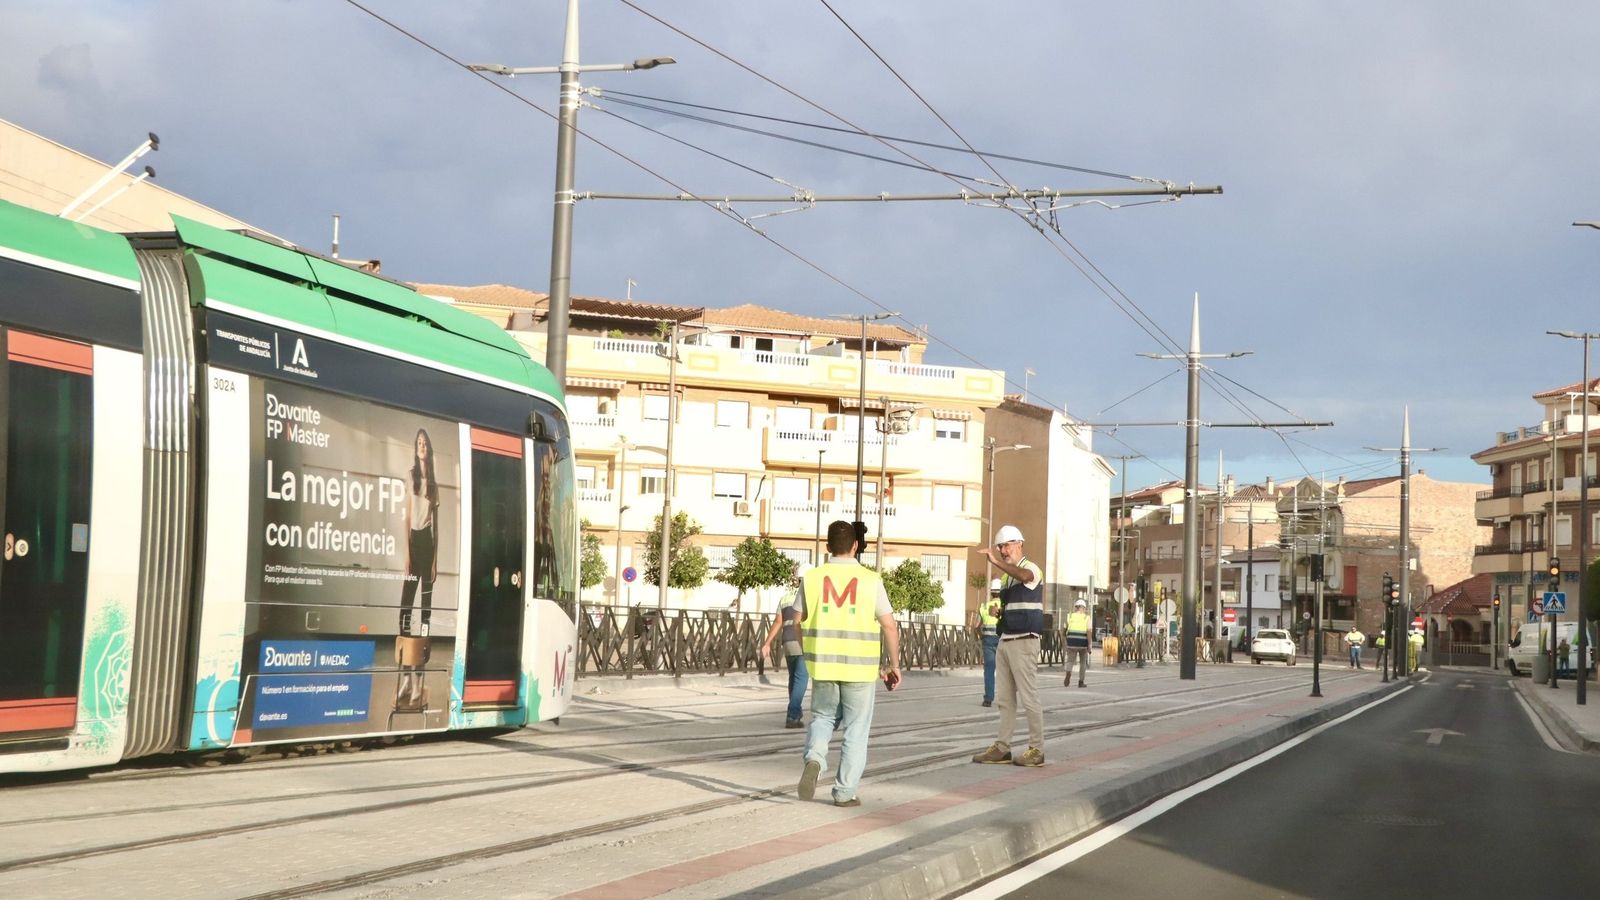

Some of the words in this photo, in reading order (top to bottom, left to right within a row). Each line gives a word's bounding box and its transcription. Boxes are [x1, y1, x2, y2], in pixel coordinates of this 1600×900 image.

[216, 329, 248, 344] TRANSPORTES
[239, 344, 246, 353] DE
[292, 338, 309, 368] A
[213, 377, 236, 392] 302A
[266, 393, 321, 425] Davante
[266, 420, 283, 439] FP
[287, 423, 330, 448] Master
[266, 459, 296, 502] La
[303, 471, 374, 519] mejor
[265, 522, 303, 548] con
[306, 521, 396, 556] diferencia
[822, 575, 858, 609] M
[264, 647, 311, 667] Davante
[325, 654, 350, 666] MEDAC
[552, 650, 566, 691] M
[259, 712, 288, 722] davante.es
